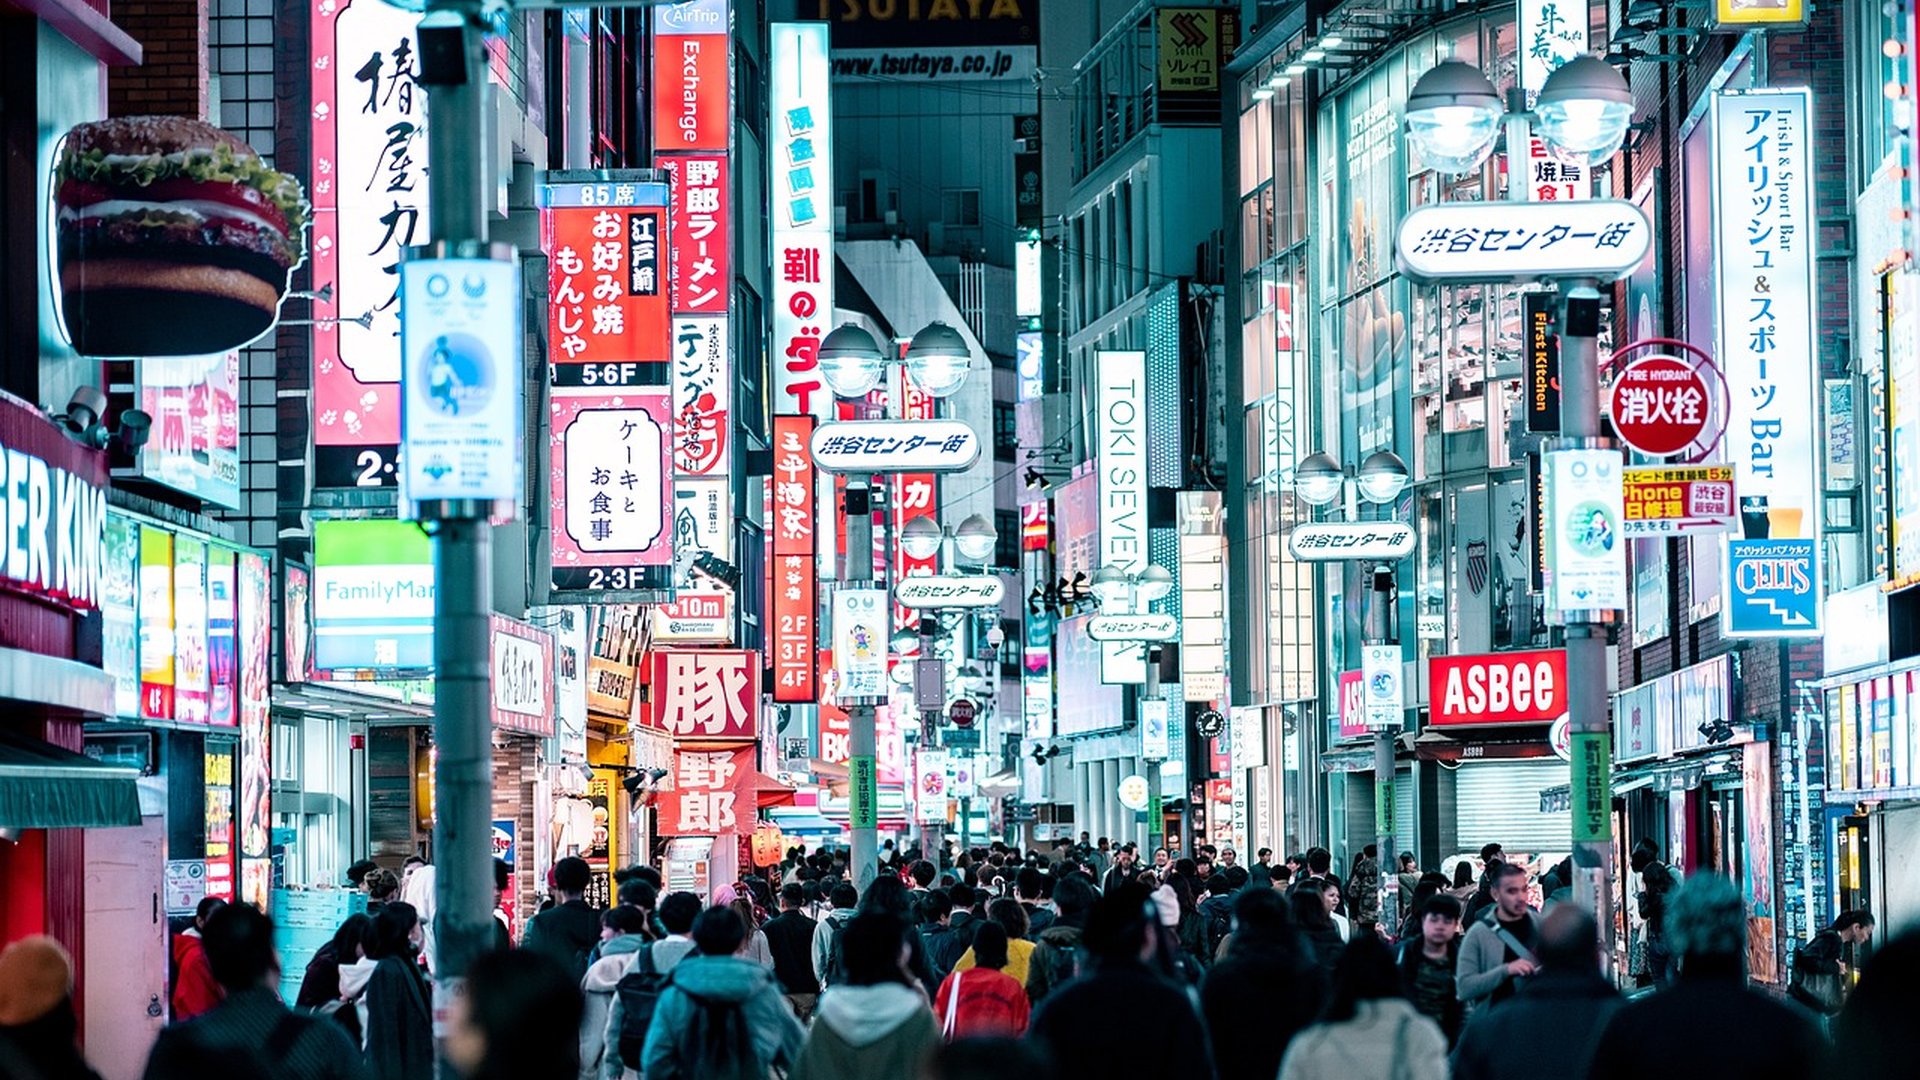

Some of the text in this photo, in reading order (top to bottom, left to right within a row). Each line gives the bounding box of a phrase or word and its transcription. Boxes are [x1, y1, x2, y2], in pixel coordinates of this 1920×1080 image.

[673, 9, 719, 24] AirTrip
[679, 40, 700, 142] Exchange
[1167, 59, 1212, 74] ソレイユ
[580, 185, 635, 206] 85席
[1774, 109, 1794, 252] Irish & Sport Bar
[630, 217, 654, 292] 江戸前
[686, 160, 720, 309] 野郎ラーメン
[1412, 222, 1636, 254] 渋谷センター街
[591, 209, 624, 335] お好み焼
[555, 245, 588, 358] もんじゃ
[1535, 312, 1548, 412] First Kitchen
[1626, 369, 1693, 382] FIRE HYDRANT
[1109, 378, 1136, 456] TOKI
[1619, 386, 1702, 425] 消火栓
[619, 419, 639, 513] ケーキと
[819, 434, 969, 455] 渋谷センター街
[590, 466, 613, 541] お食事
[1695, 485, 1726, 500] 渋谷
[56, 467, 107, 612] KING
[1297, 531, 1408, 549] 渋谷センター街
[1735, 558, 1811, 595] CELTS
[781, 615, 808, 632] 2F
[781, 642, 808, 660] 3F
[661, 652, 750, 735] 豚
[781, 670, 808, 687] 4F
[1443, 661, 1554, 715] ASBee
[678, 750, 738, 833] 野郎
